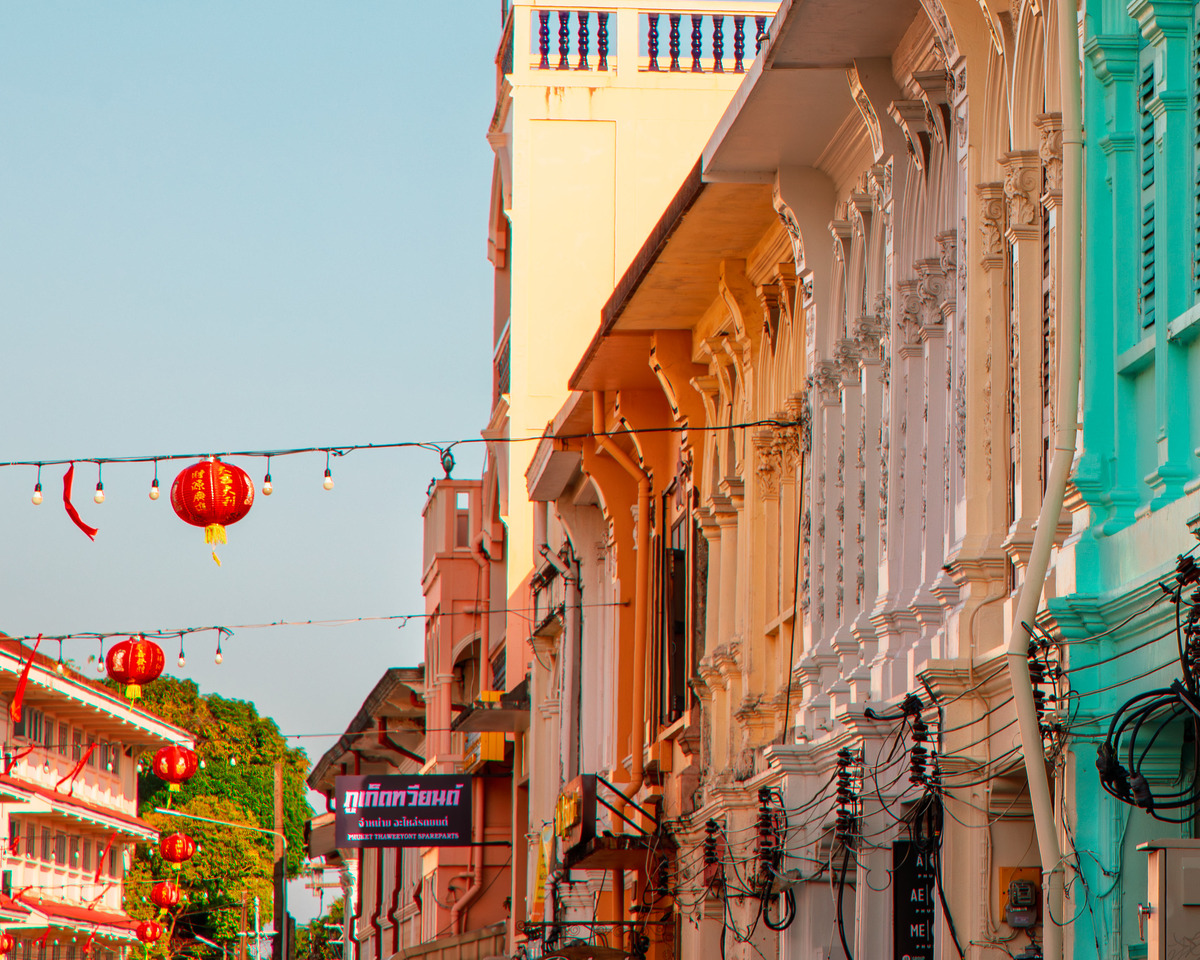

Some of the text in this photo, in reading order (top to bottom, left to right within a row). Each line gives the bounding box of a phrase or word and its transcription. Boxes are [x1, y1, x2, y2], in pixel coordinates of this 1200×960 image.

[347, 833, 373, 841] PHUKET
[417, 832, 460, 840] SPAREPARTS
[910, 888, 925, 902] AE
[910, 924, 926, 937] ME
